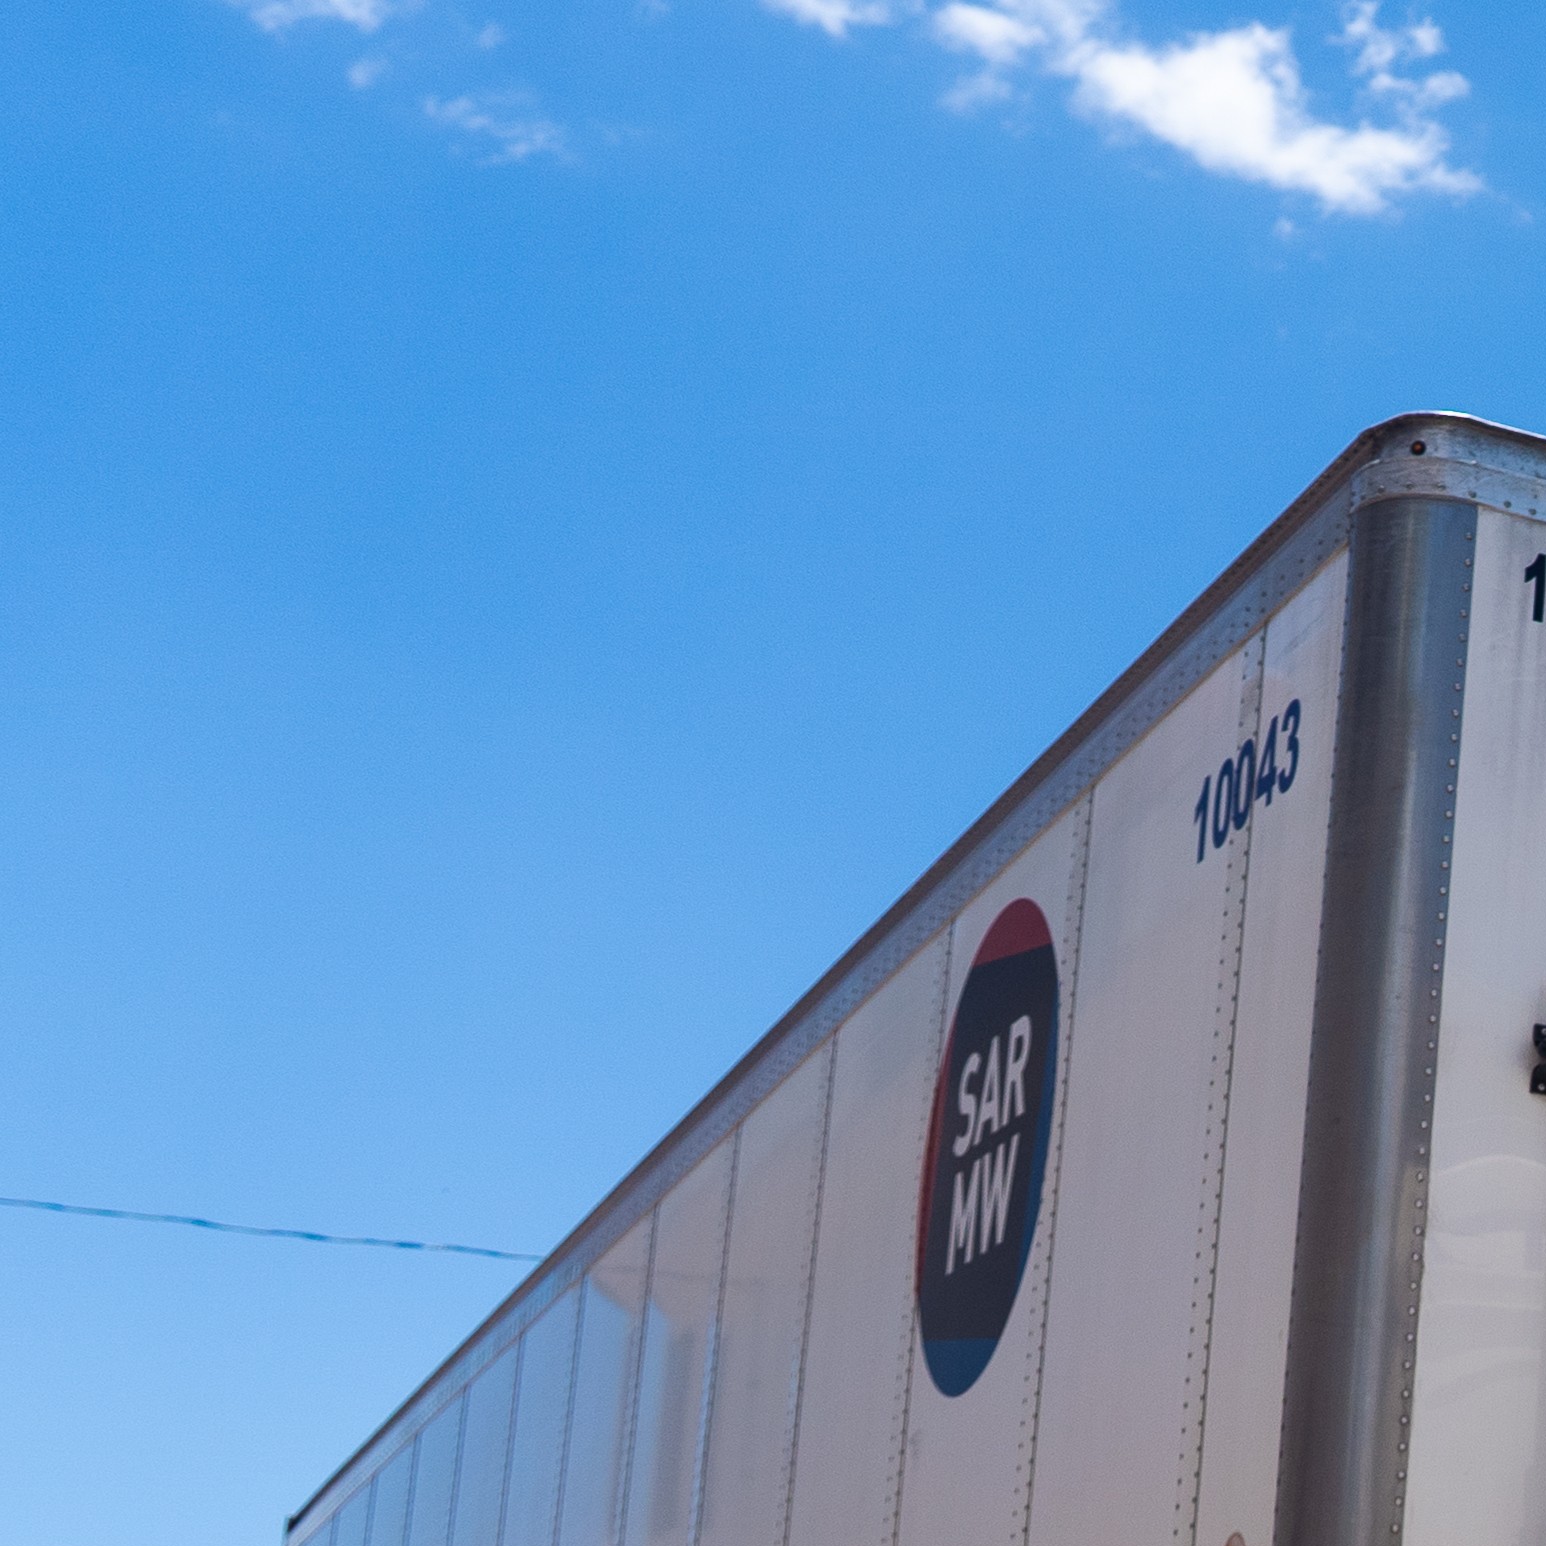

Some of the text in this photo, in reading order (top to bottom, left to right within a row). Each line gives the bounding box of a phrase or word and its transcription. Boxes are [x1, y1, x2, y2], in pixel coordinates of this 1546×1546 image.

[1193, 699, 1300, 863] 10043
[952, 1014, 1033, 1158] SAR
[944, 1132, 1021, 1277] MW
